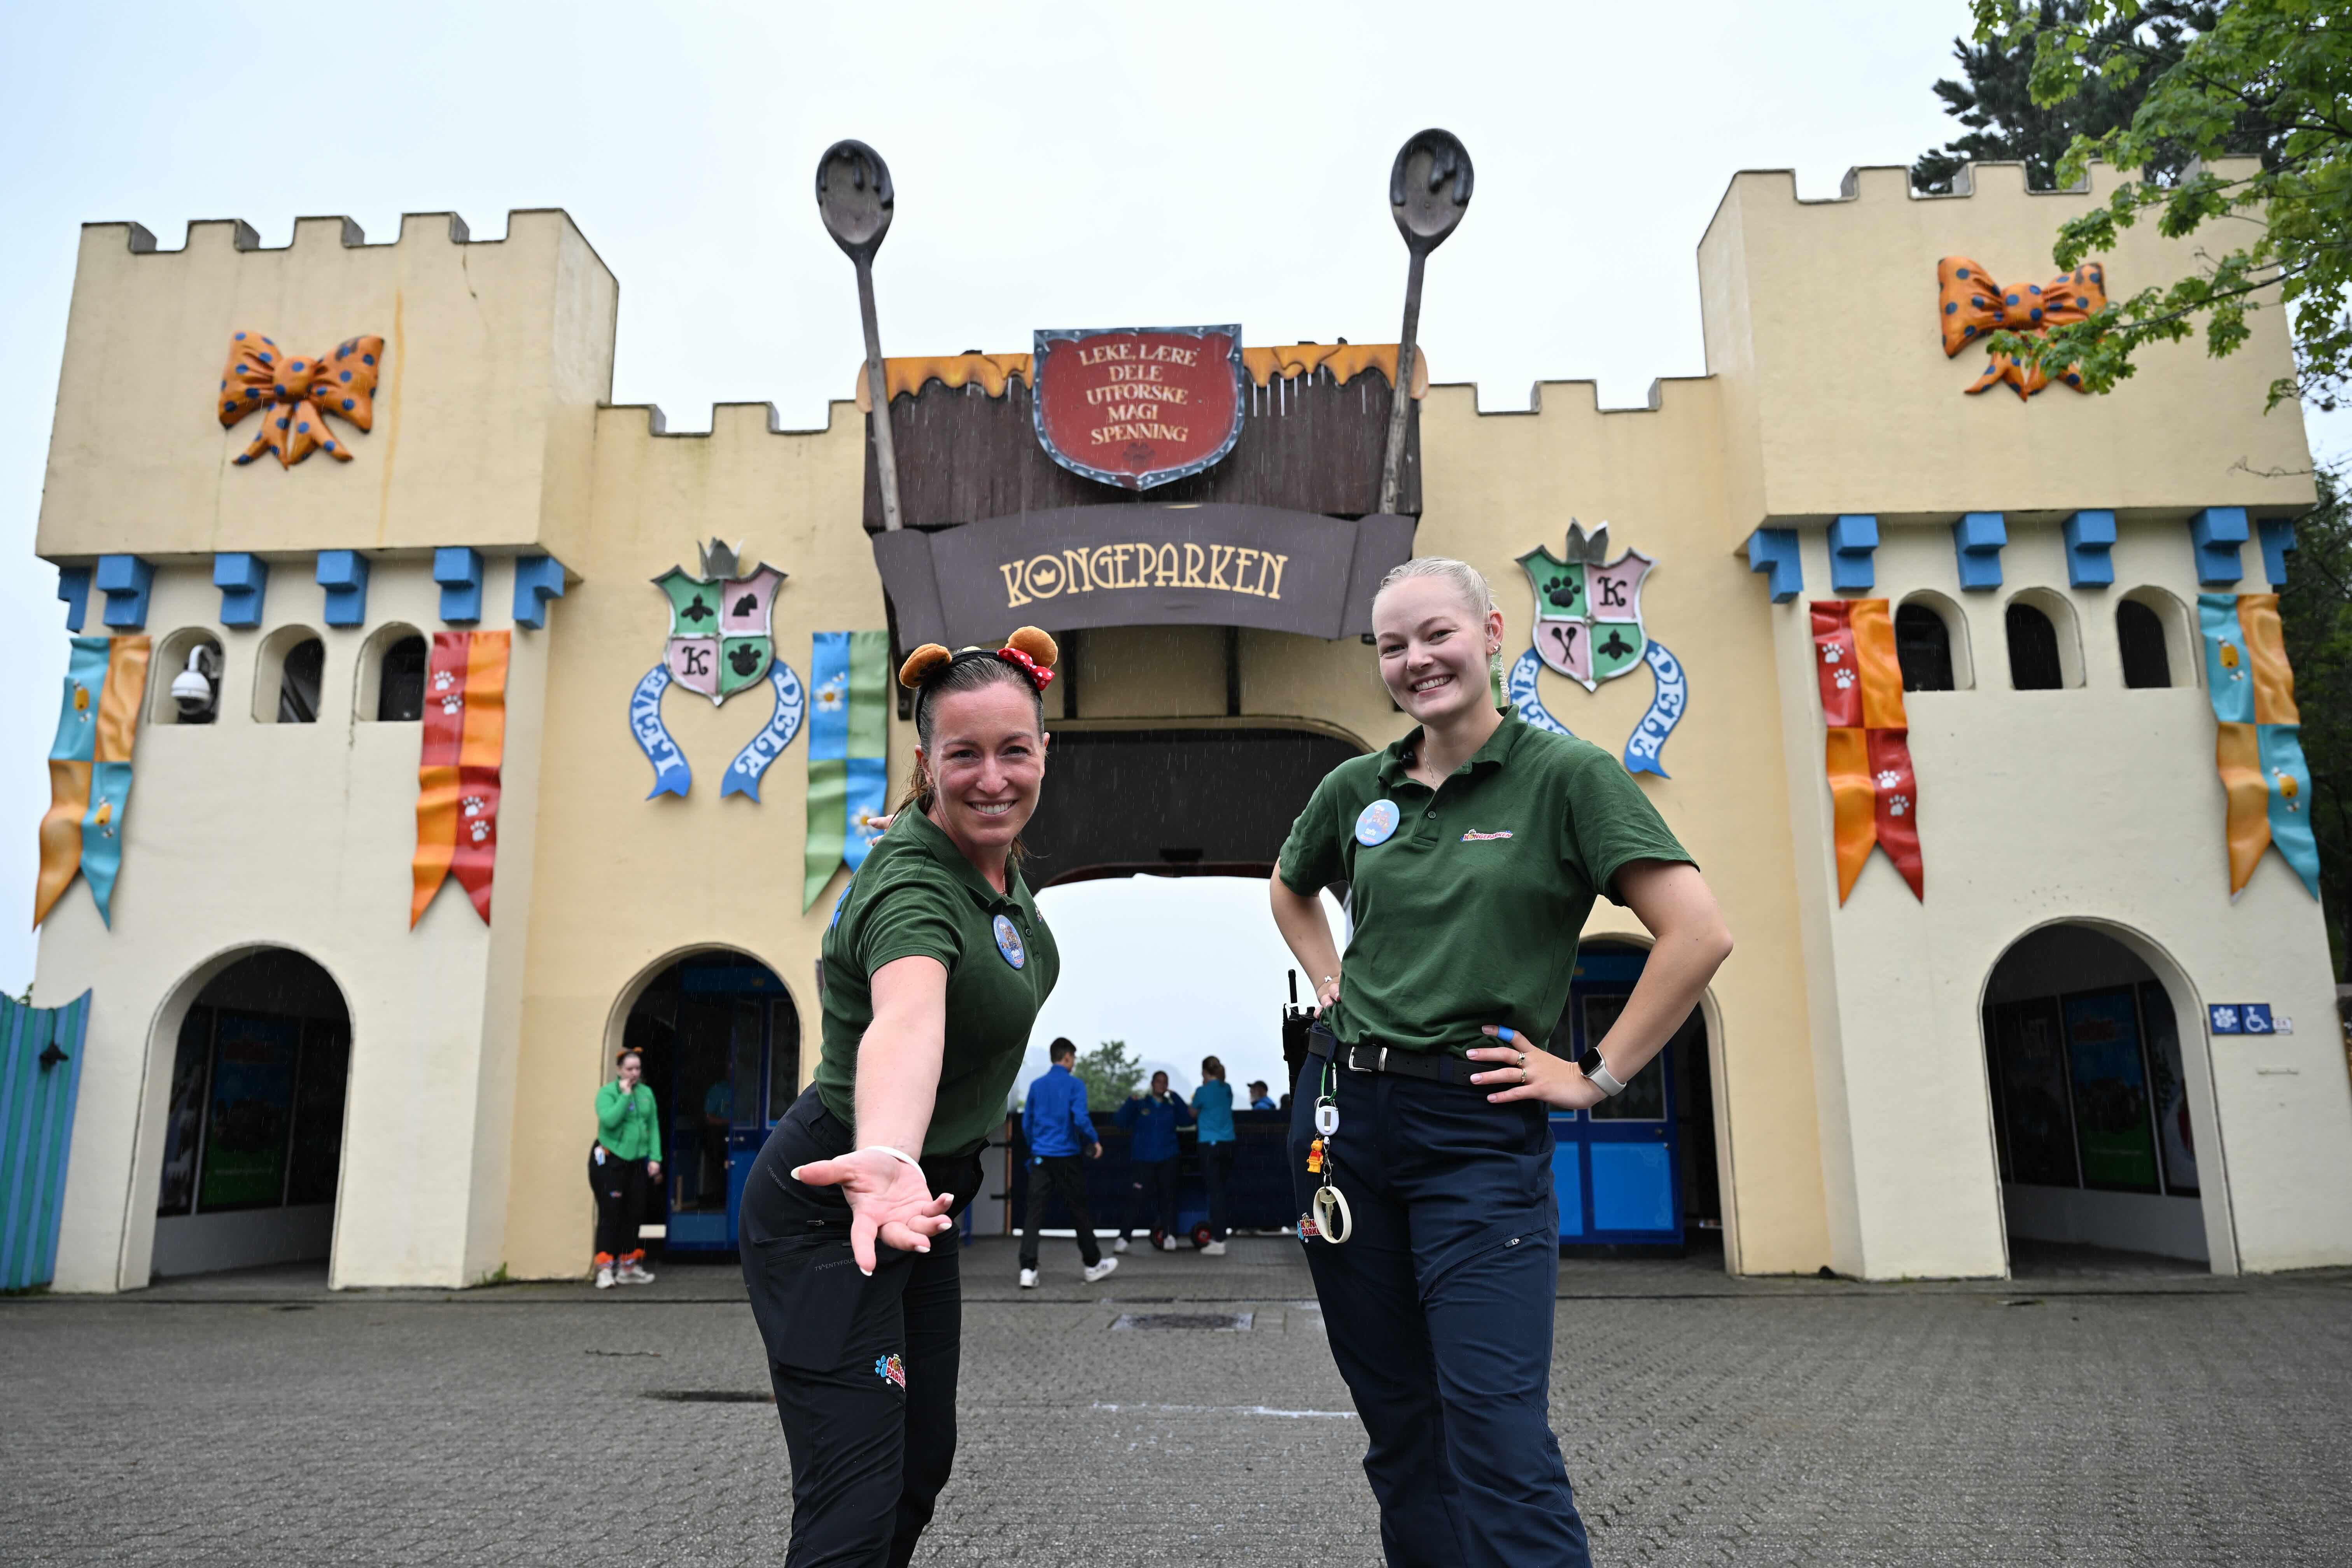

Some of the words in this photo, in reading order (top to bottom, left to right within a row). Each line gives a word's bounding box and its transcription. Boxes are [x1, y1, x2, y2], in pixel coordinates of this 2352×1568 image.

[1079, 343, 1136, 366] LEKE,
[1139, 344, 1197, 367] LÆRE
[1109, 364, 1163, 382] DELE
[1086, 383, 1188, 405] UTFORSKE
[1108, 403, 1158, 423] MAGI
[1091, 423, 1188, 445] SPENNING
[999, 542, 1288, 607] KONGEPARKEN
[1598, 576, 1627, 606] K
[682, 647, 710, 675] K
[1629, 646, 1684, 759] DELE
[734, 668, 803, 777] DELE
